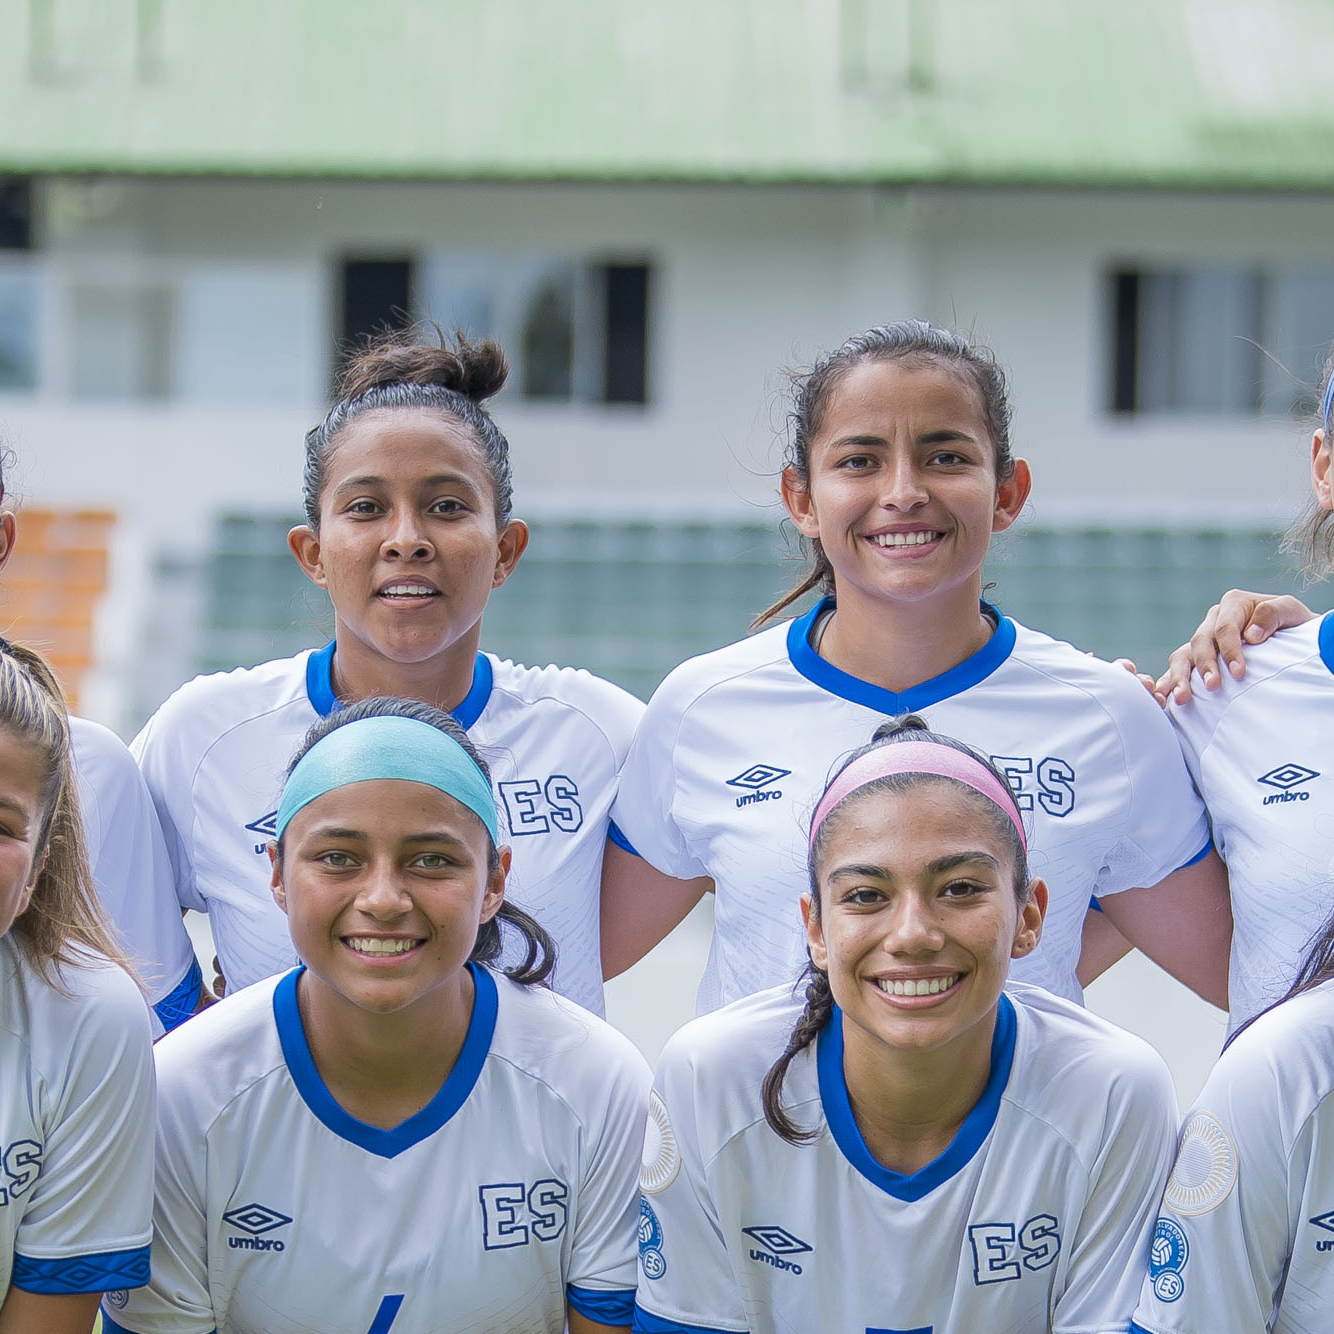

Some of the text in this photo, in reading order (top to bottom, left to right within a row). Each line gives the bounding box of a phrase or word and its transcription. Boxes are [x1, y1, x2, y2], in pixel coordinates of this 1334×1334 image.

[992, 756, 1075, 817] ES
[1262, 790, 1310, 805] umbro
[499, 775, 582, 836] ES
[735, 790, 782, 808] umbro
[478, 1178, 568, 1251] ES
[228, 1236, 285, 1252] umbro
[969, 1213, 1060, 1286] ES
[646, 1255, 661, 1273] ES
[749, 1248, 803, 1276] umbro
[1160, 1277, 1178, 1295] ES
